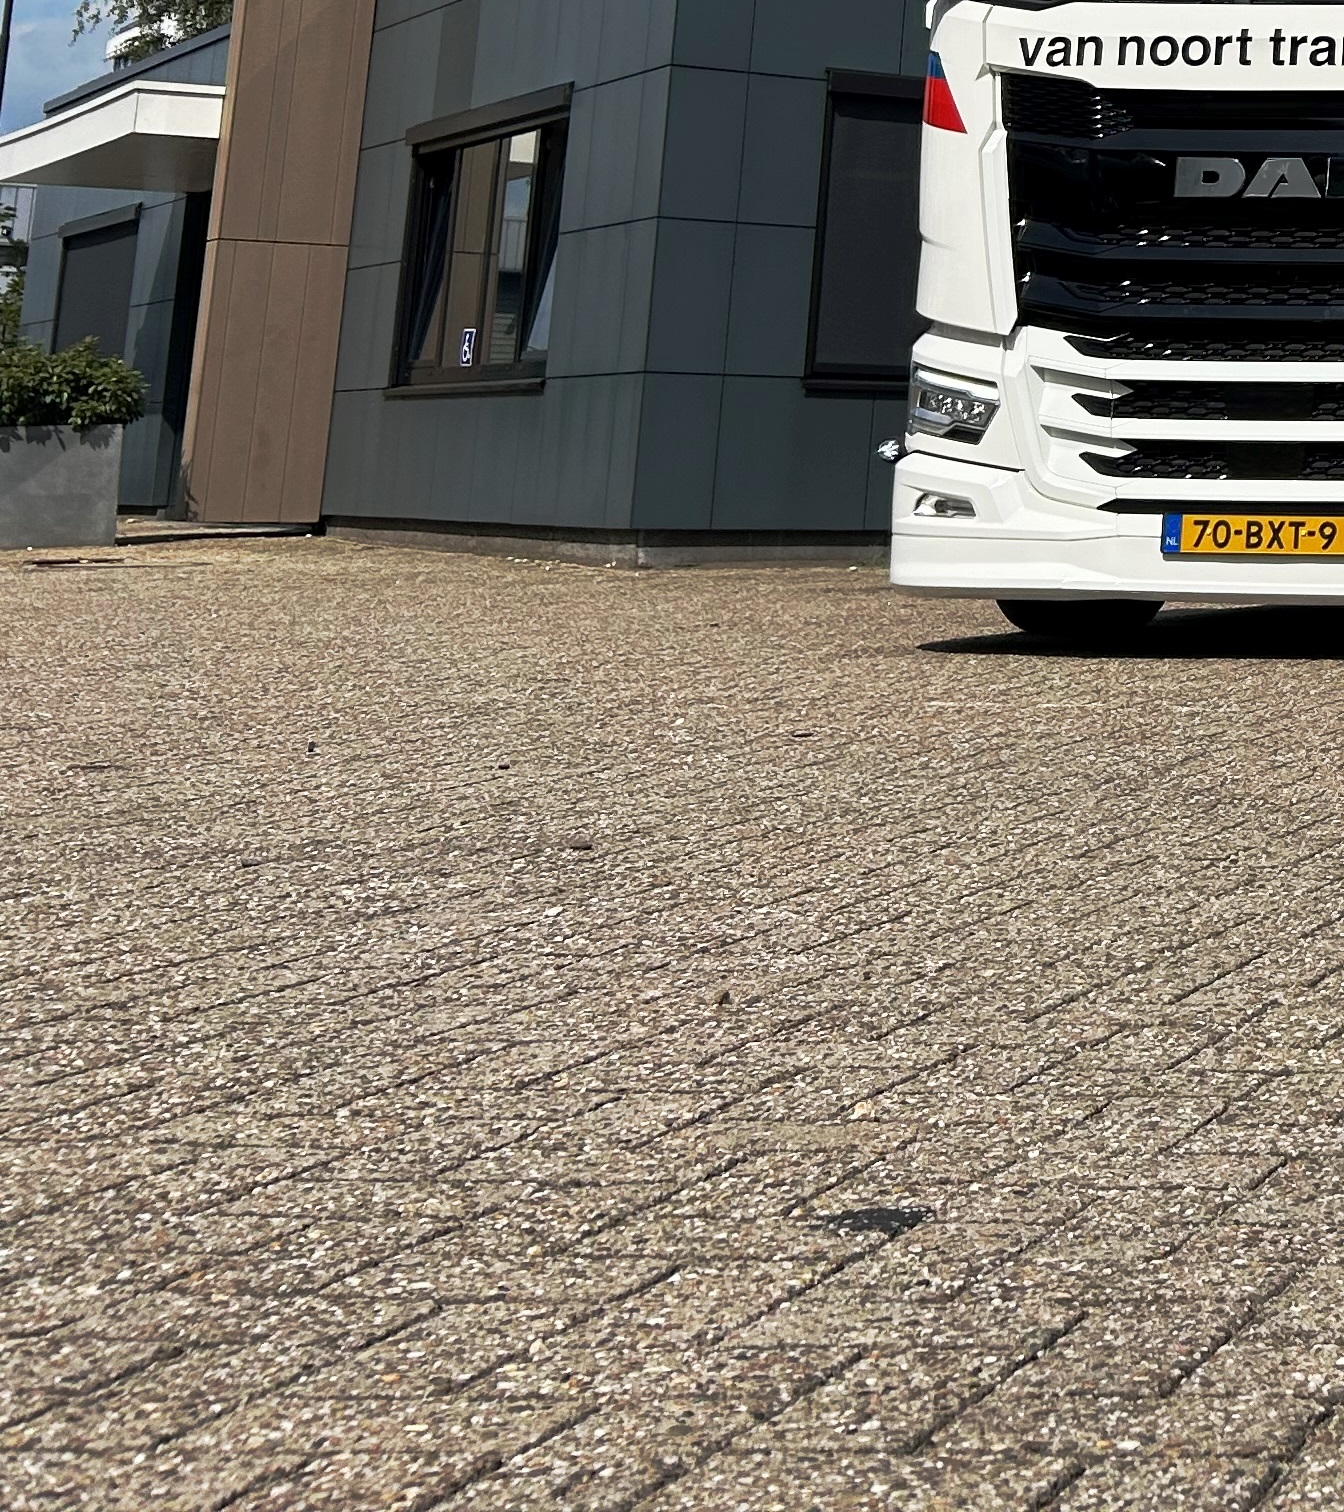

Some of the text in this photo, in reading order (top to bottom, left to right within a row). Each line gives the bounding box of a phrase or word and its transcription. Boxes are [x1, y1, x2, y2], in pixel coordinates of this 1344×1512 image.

[1018, 35, 1104, 68] van
[1117, 28, 1253, 67] noort
[1192, 519, 1338, 551] 70-BXT-9
